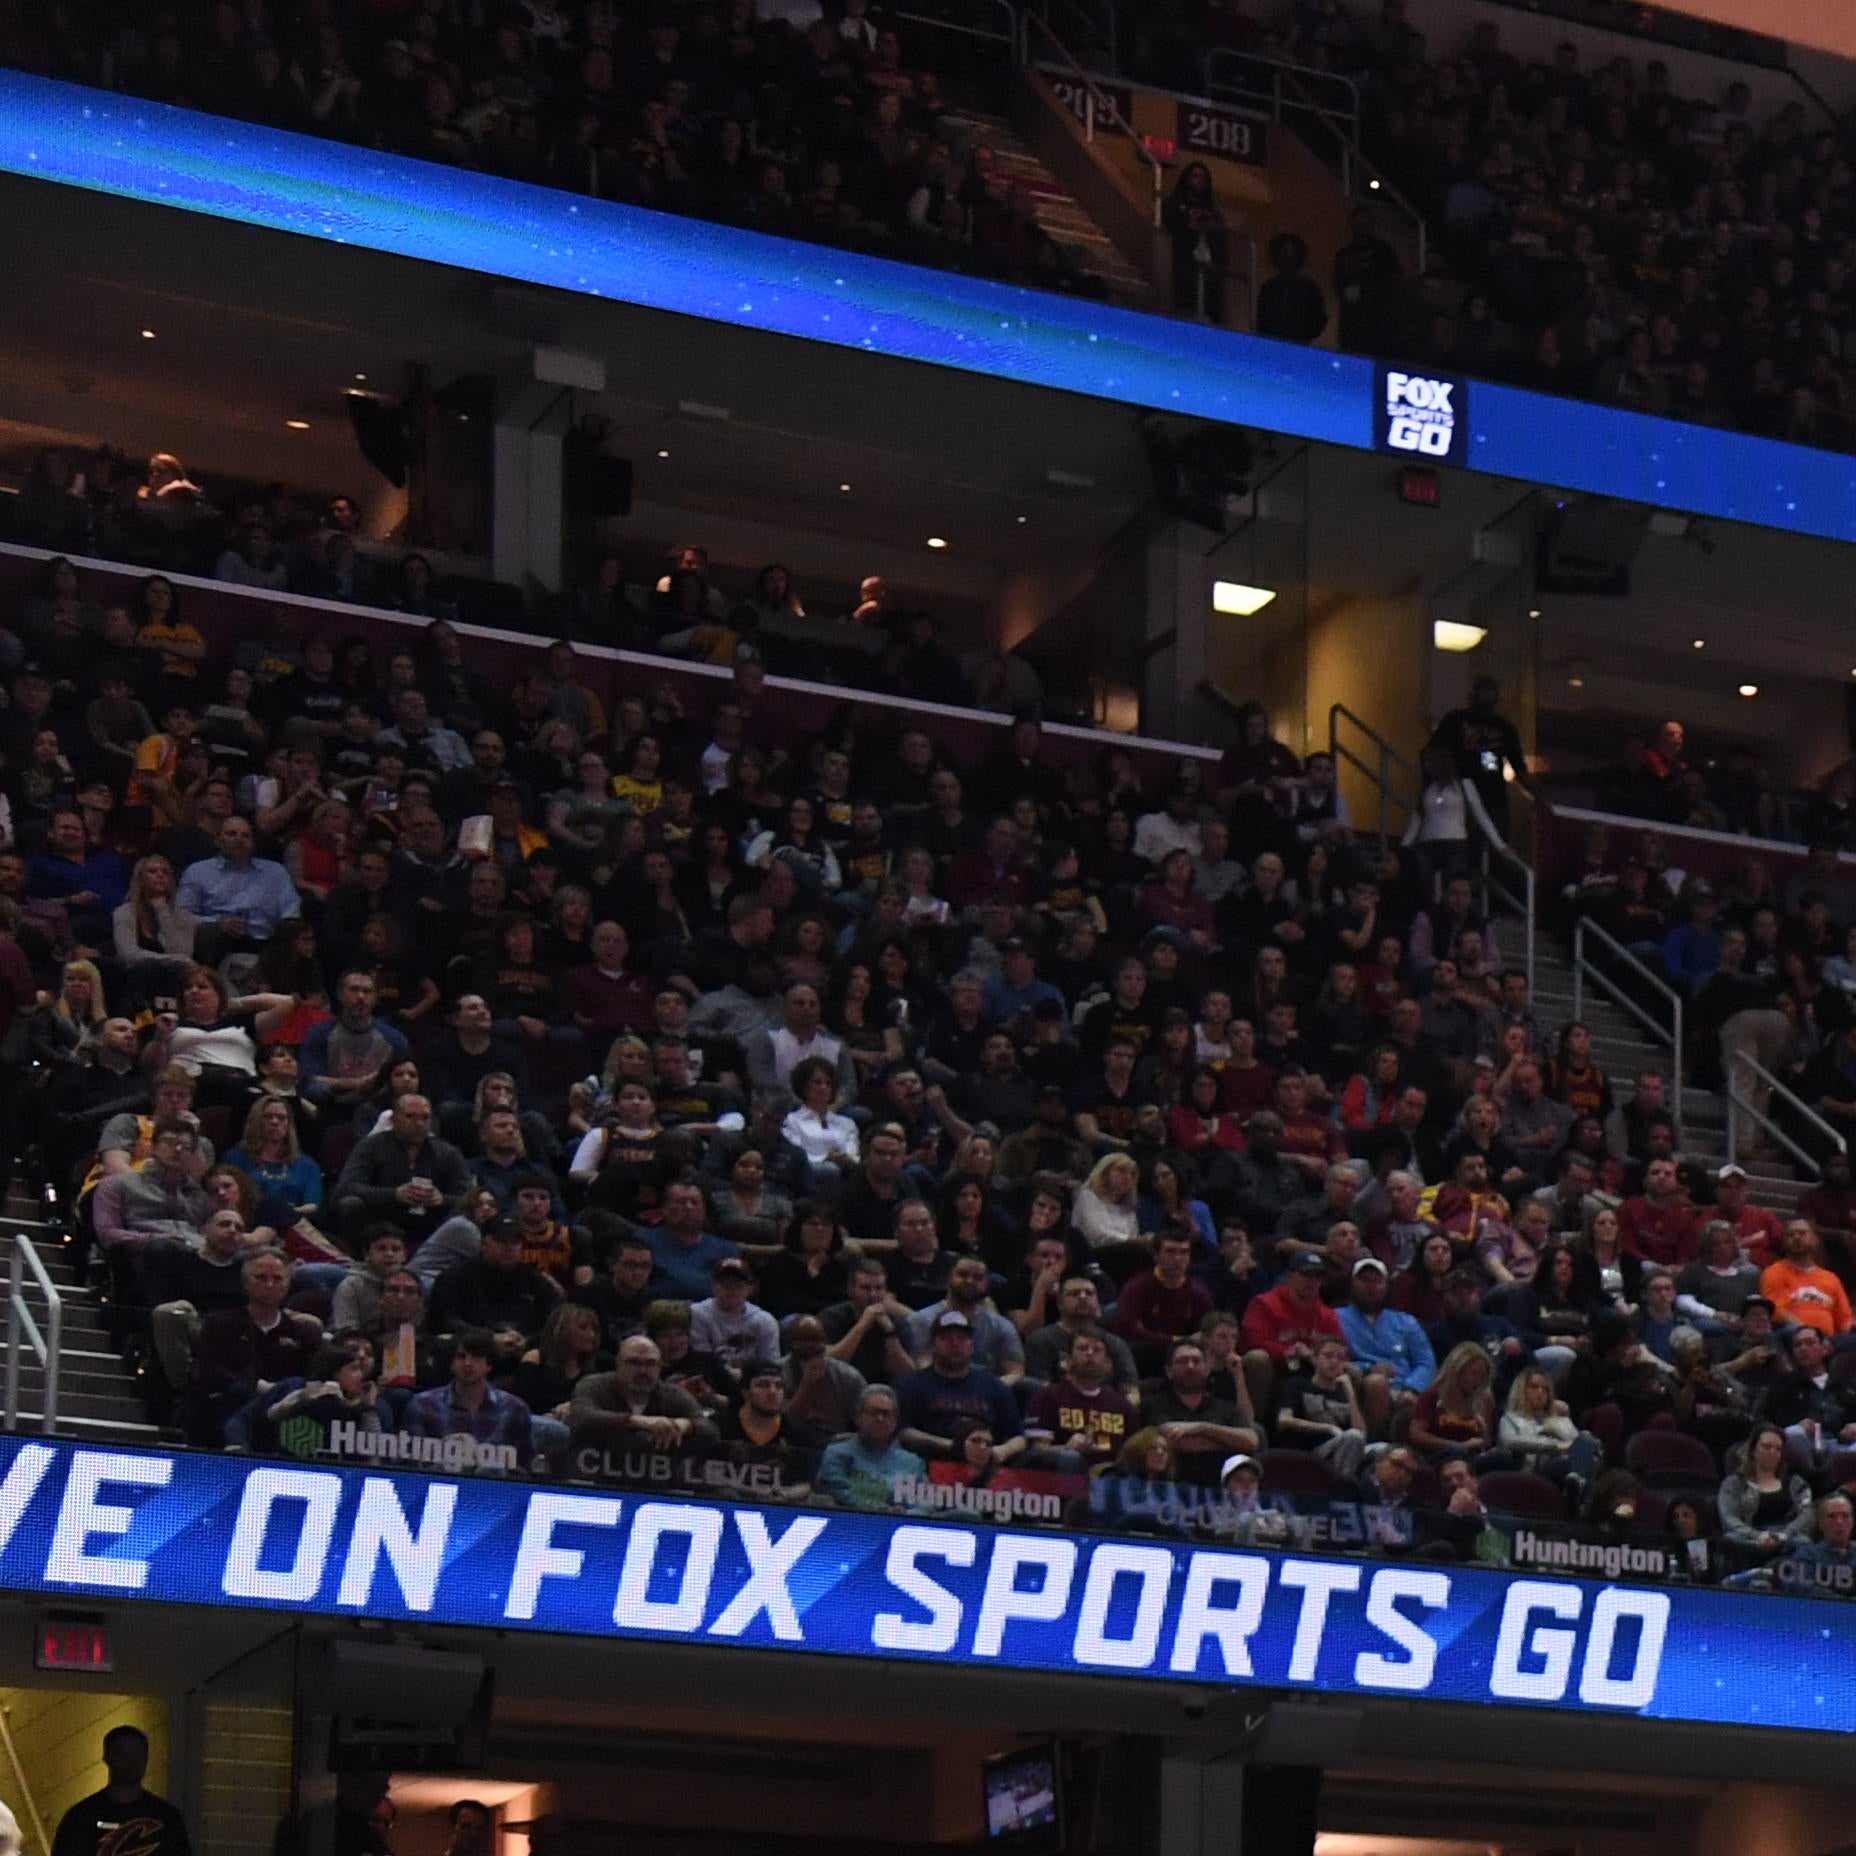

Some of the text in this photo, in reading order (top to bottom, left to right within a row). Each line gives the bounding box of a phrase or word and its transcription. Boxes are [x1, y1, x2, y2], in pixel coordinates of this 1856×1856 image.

[1188, 112, 1252, 156] 208
[1387, 371, 1455, 414] FOX
[1388, 415, 1453, 457] GO
[329, 1418, 1061, 1523] Huntington CLUB LEVEL Huntington
[1514, 1529, 1664, 1580] Huntington
[1777, 1557, 1853, 1588] CLUB
[221, 1468, 460, 1612] ON
[504, 1492, 828, 1641] FOX
[872, 1524, 1450, 1691] SPORTS
[1488, 1578, 1672, 1708] GO
